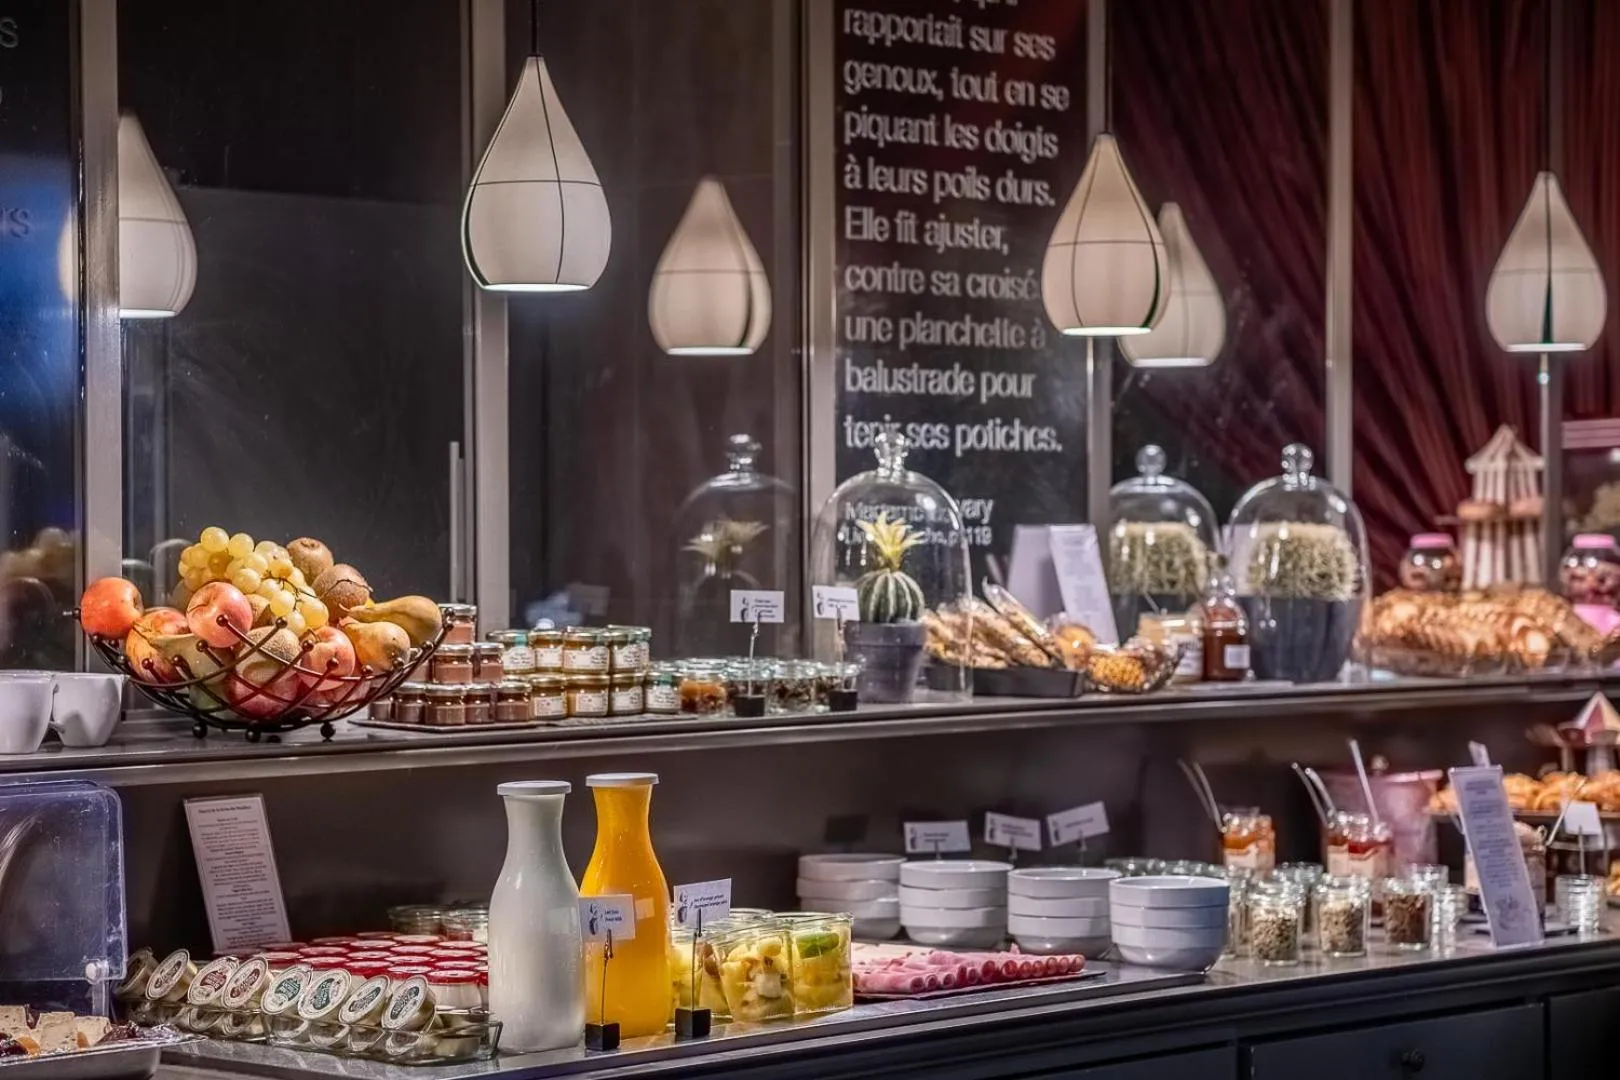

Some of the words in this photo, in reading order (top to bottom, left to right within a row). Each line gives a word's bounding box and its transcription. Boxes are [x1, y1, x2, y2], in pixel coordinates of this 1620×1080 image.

[844, 9, 964, 48] rapportait
[969, 25, 1008, 54] sur
[1013, 31, 1056, 61] ses
[844, 60, 943, 101] genoux,
[949, 66, 1000, 104] tout
[1004, 80, 1036, 107] en
[1041, 84, 1070, 111] se
[844, 106, 938, 148] piquant
[944, 115, 980, 151] les
[984, 120, 1059, 164] doigts
[844, 154, 862, 190] à
[868, 157, 928, 195] leurs
[934, 166, 991, 204] poils
[996, 170, 1056, 207] durs.
[845, 206, 890, 242] Elle
[893, 210, 918, 246] fit
[924, 214, 1009, 256] ajuster,
[845, 262, 925, 294] contre
[931, 270, 961, 297] sa
[966, 268, 1040, 300] croisé
[845, 316, 893, 343] une
[899, 312, 1025, 350] planchette
[1030, 318, 1046, 349] à
[845, 357, 976, 396] balustrade
[981, 371, 1036, 404] pour
[906, 422, 949, 450] ses
[956, 418, 1062, 457] potiches.
